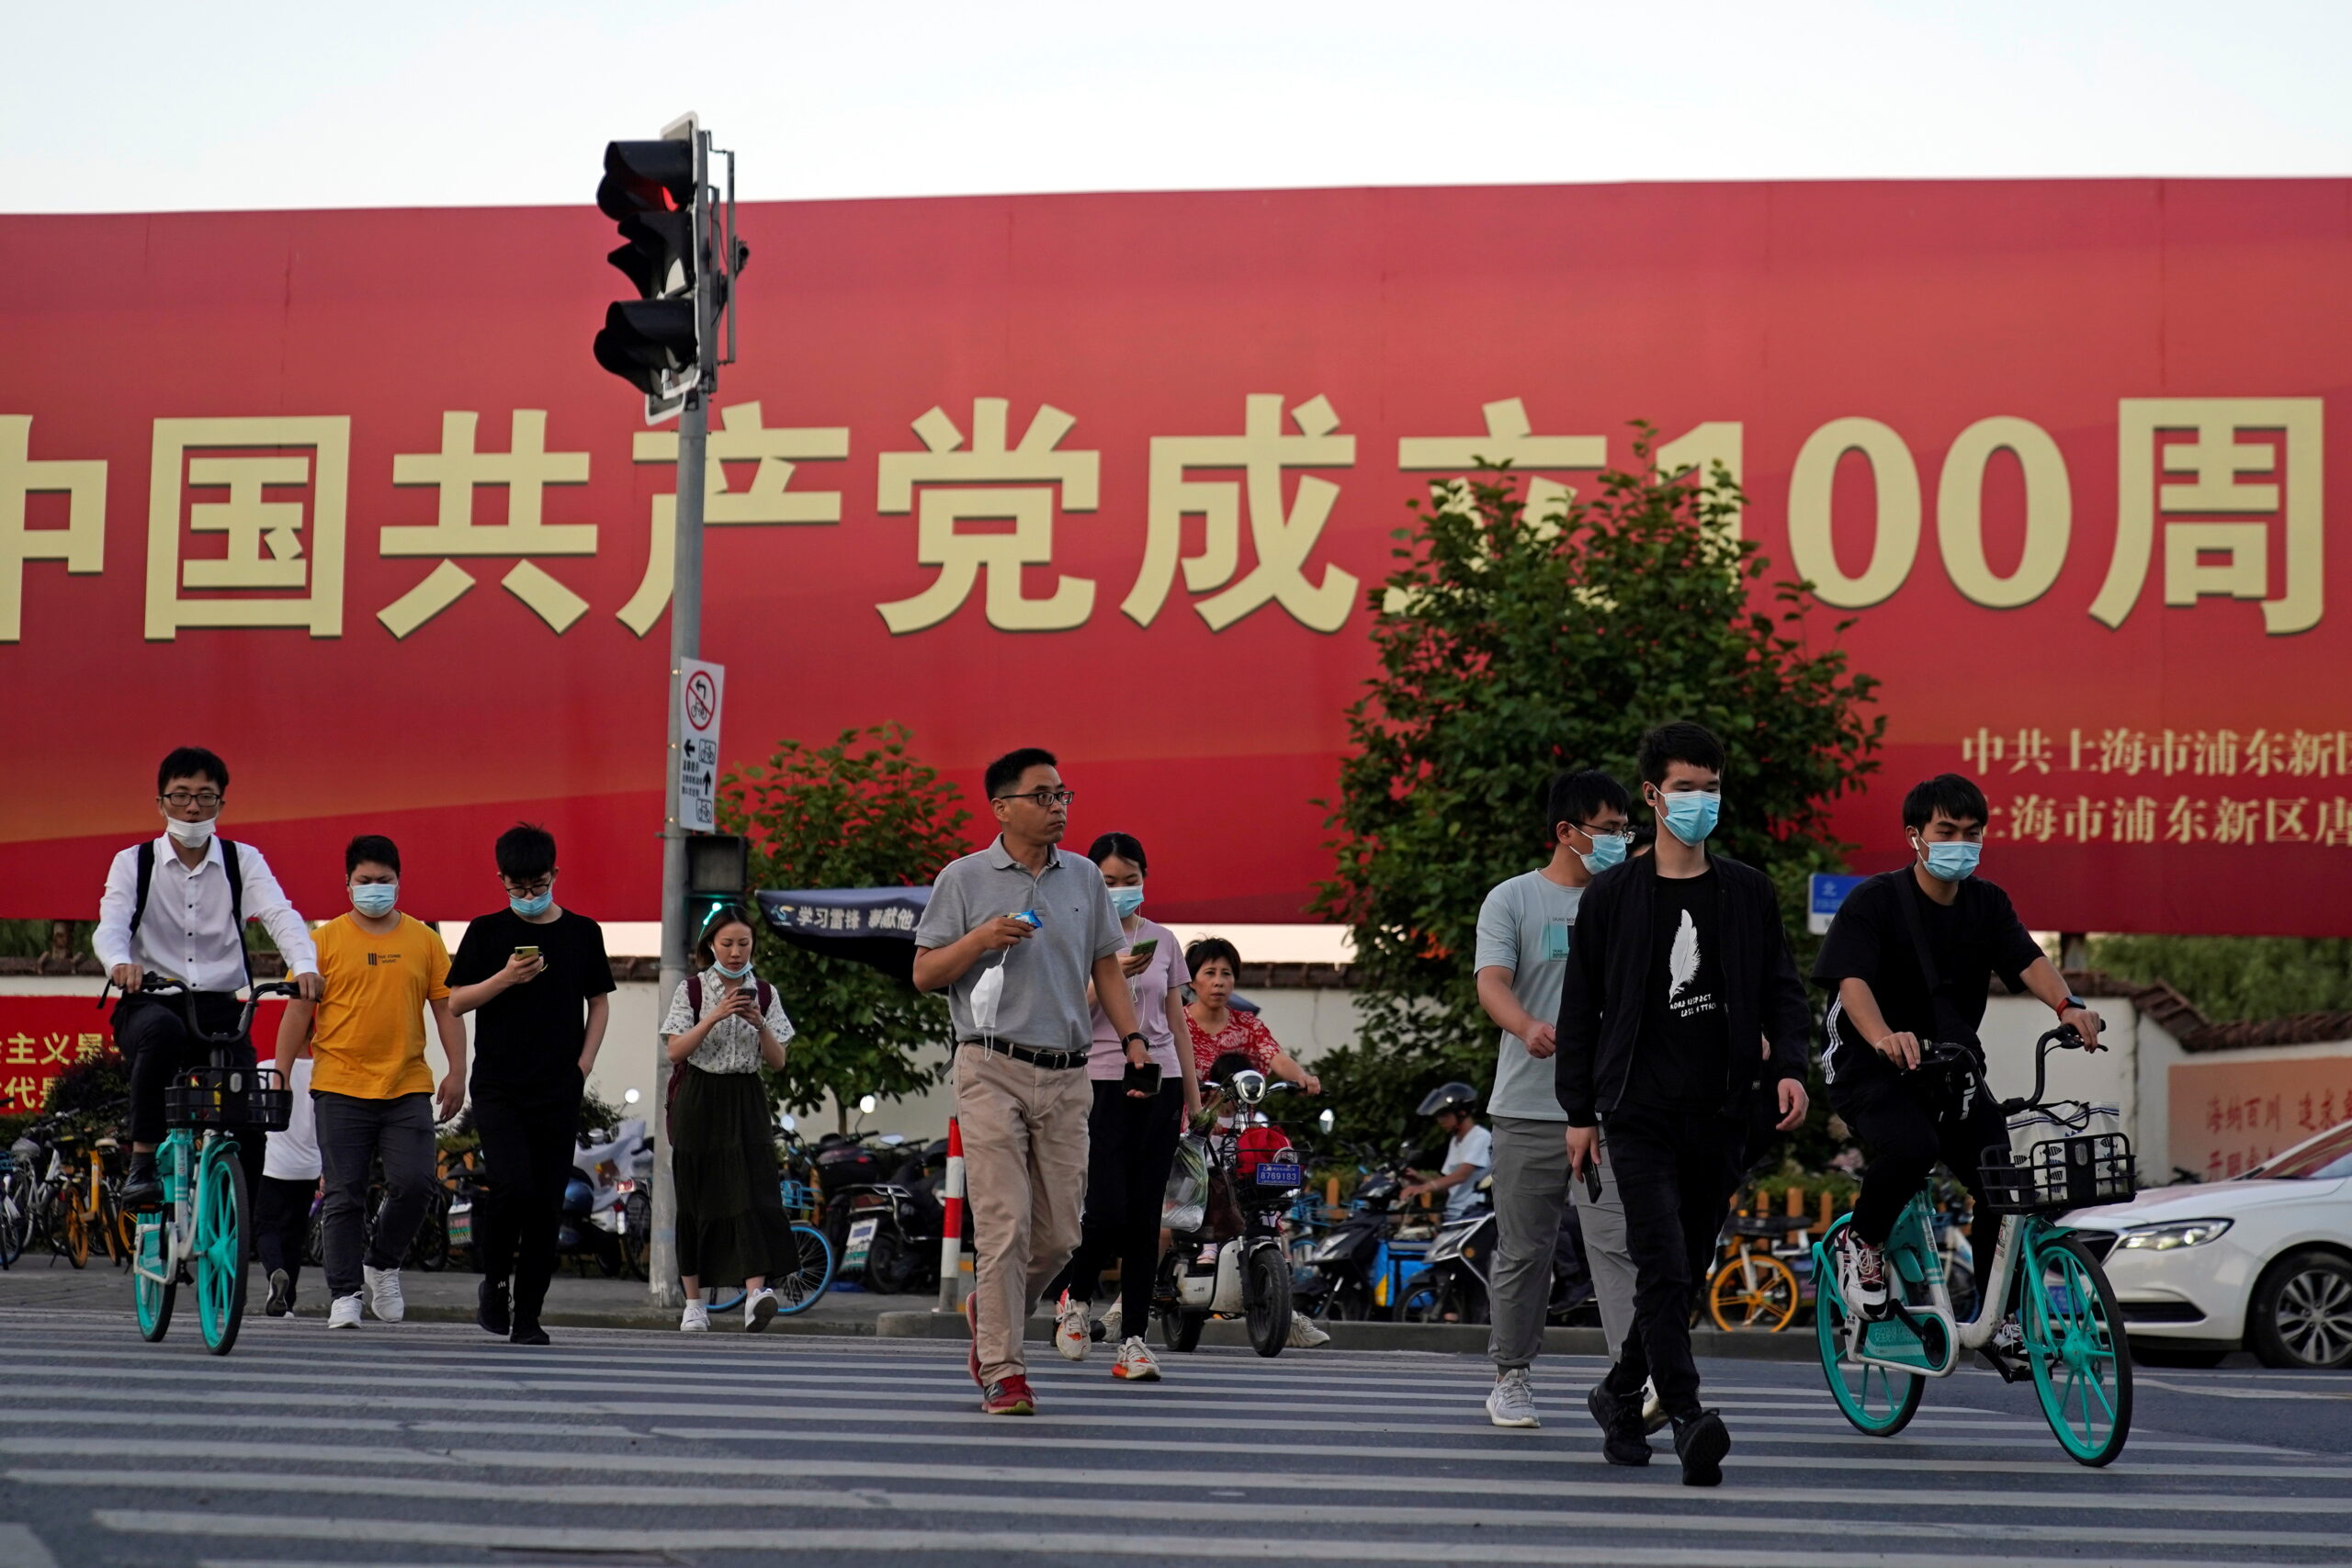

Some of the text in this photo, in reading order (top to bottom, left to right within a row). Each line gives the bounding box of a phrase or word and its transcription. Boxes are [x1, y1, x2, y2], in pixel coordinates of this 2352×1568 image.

[797, 906, 918, 932] 学习雷锋 奉献他
[0, 1032, 126, 1066] 主义是
[1260, 1171, 1297, 1181] 8769183
